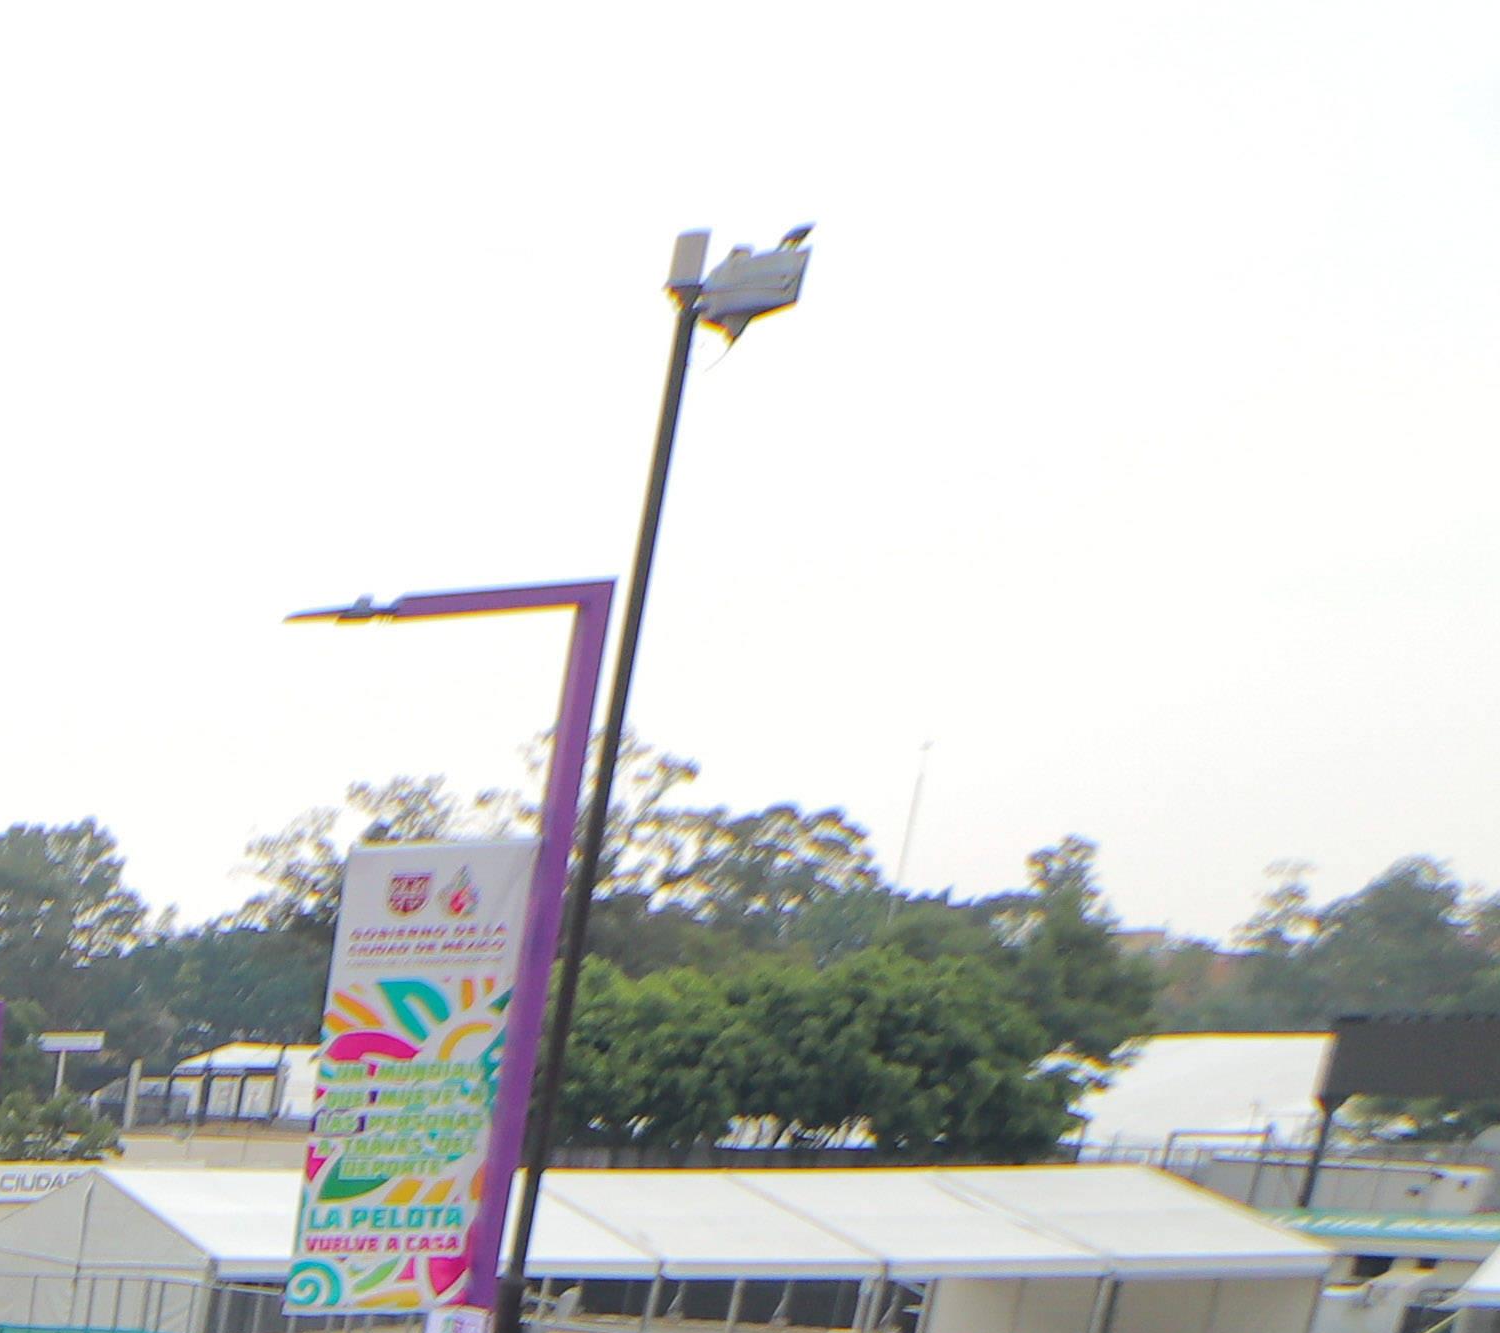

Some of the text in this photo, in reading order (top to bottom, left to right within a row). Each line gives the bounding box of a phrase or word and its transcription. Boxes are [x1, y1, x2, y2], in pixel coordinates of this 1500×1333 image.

[350, 925, 449, 941] GOBIERNO
[453, 922, 478, 937] DE
[349, 942, 410, 957] CIUDAD
[414, 940, 437, 954] DE
[308, 1206, 463, 1230] LA PELOTA
[305, 1233, 460, 1252] VUELVE A CASA
